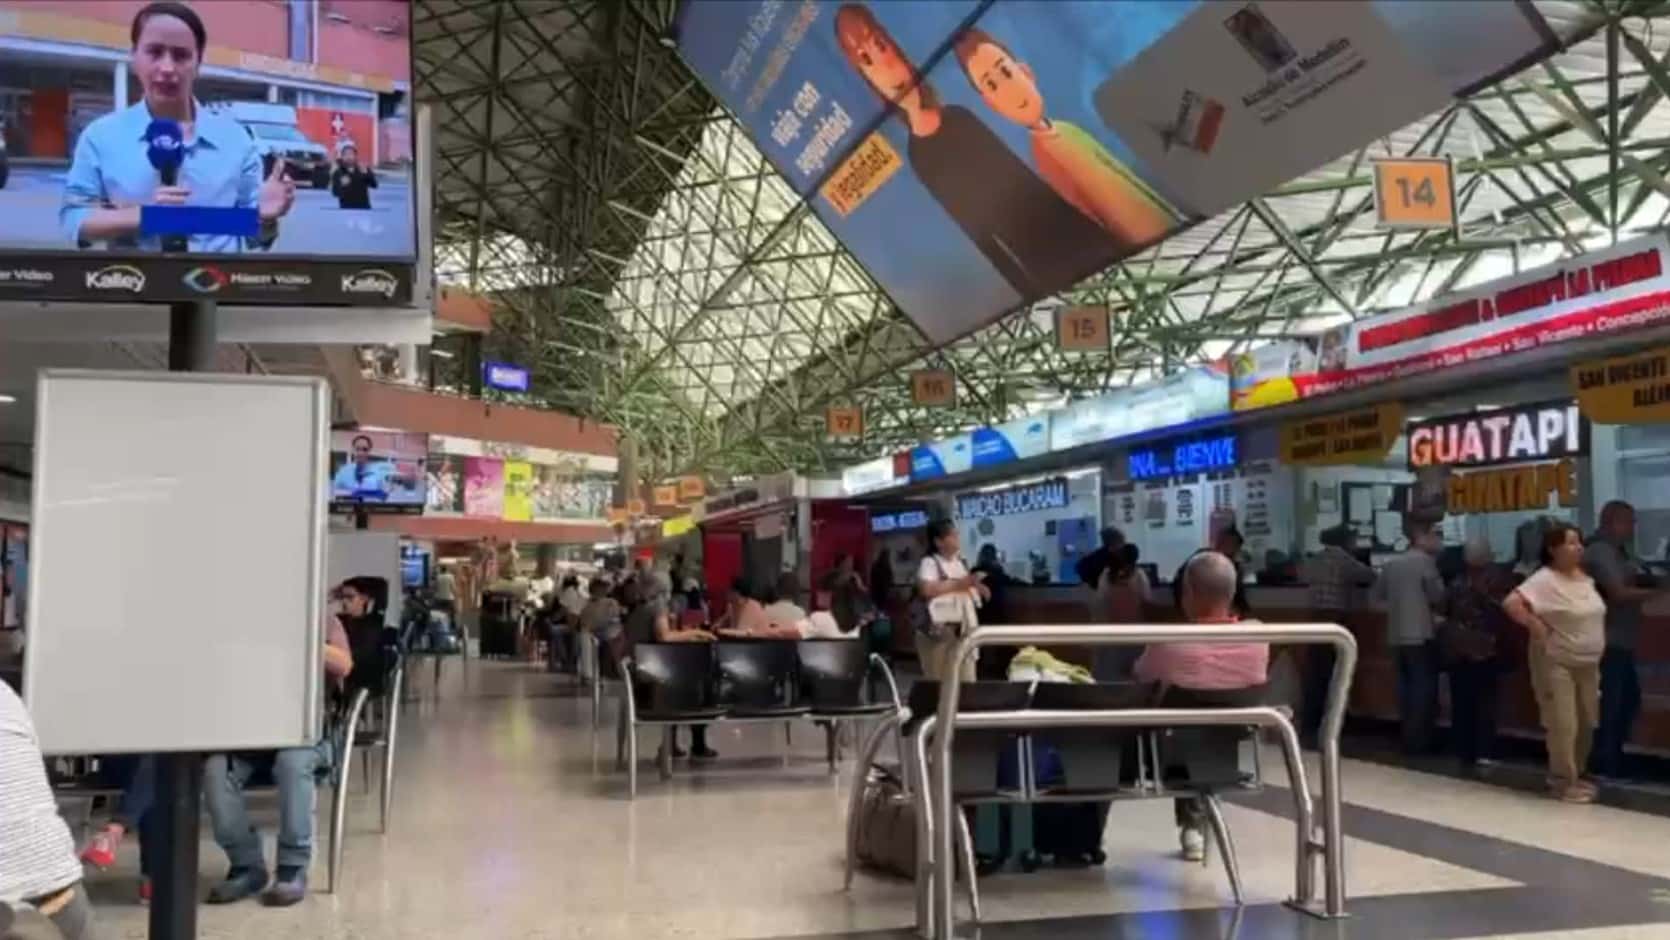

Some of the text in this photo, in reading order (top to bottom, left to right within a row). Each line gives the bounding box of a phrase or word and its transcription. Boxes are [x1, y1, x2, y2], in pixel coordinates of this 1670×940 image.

[1395, 177, 1437, 209] 14
[86, 270, 145, 293] Kalley
[341, 273, 398, 298] Kalley
[1070, 318, 1096, 340] 15
